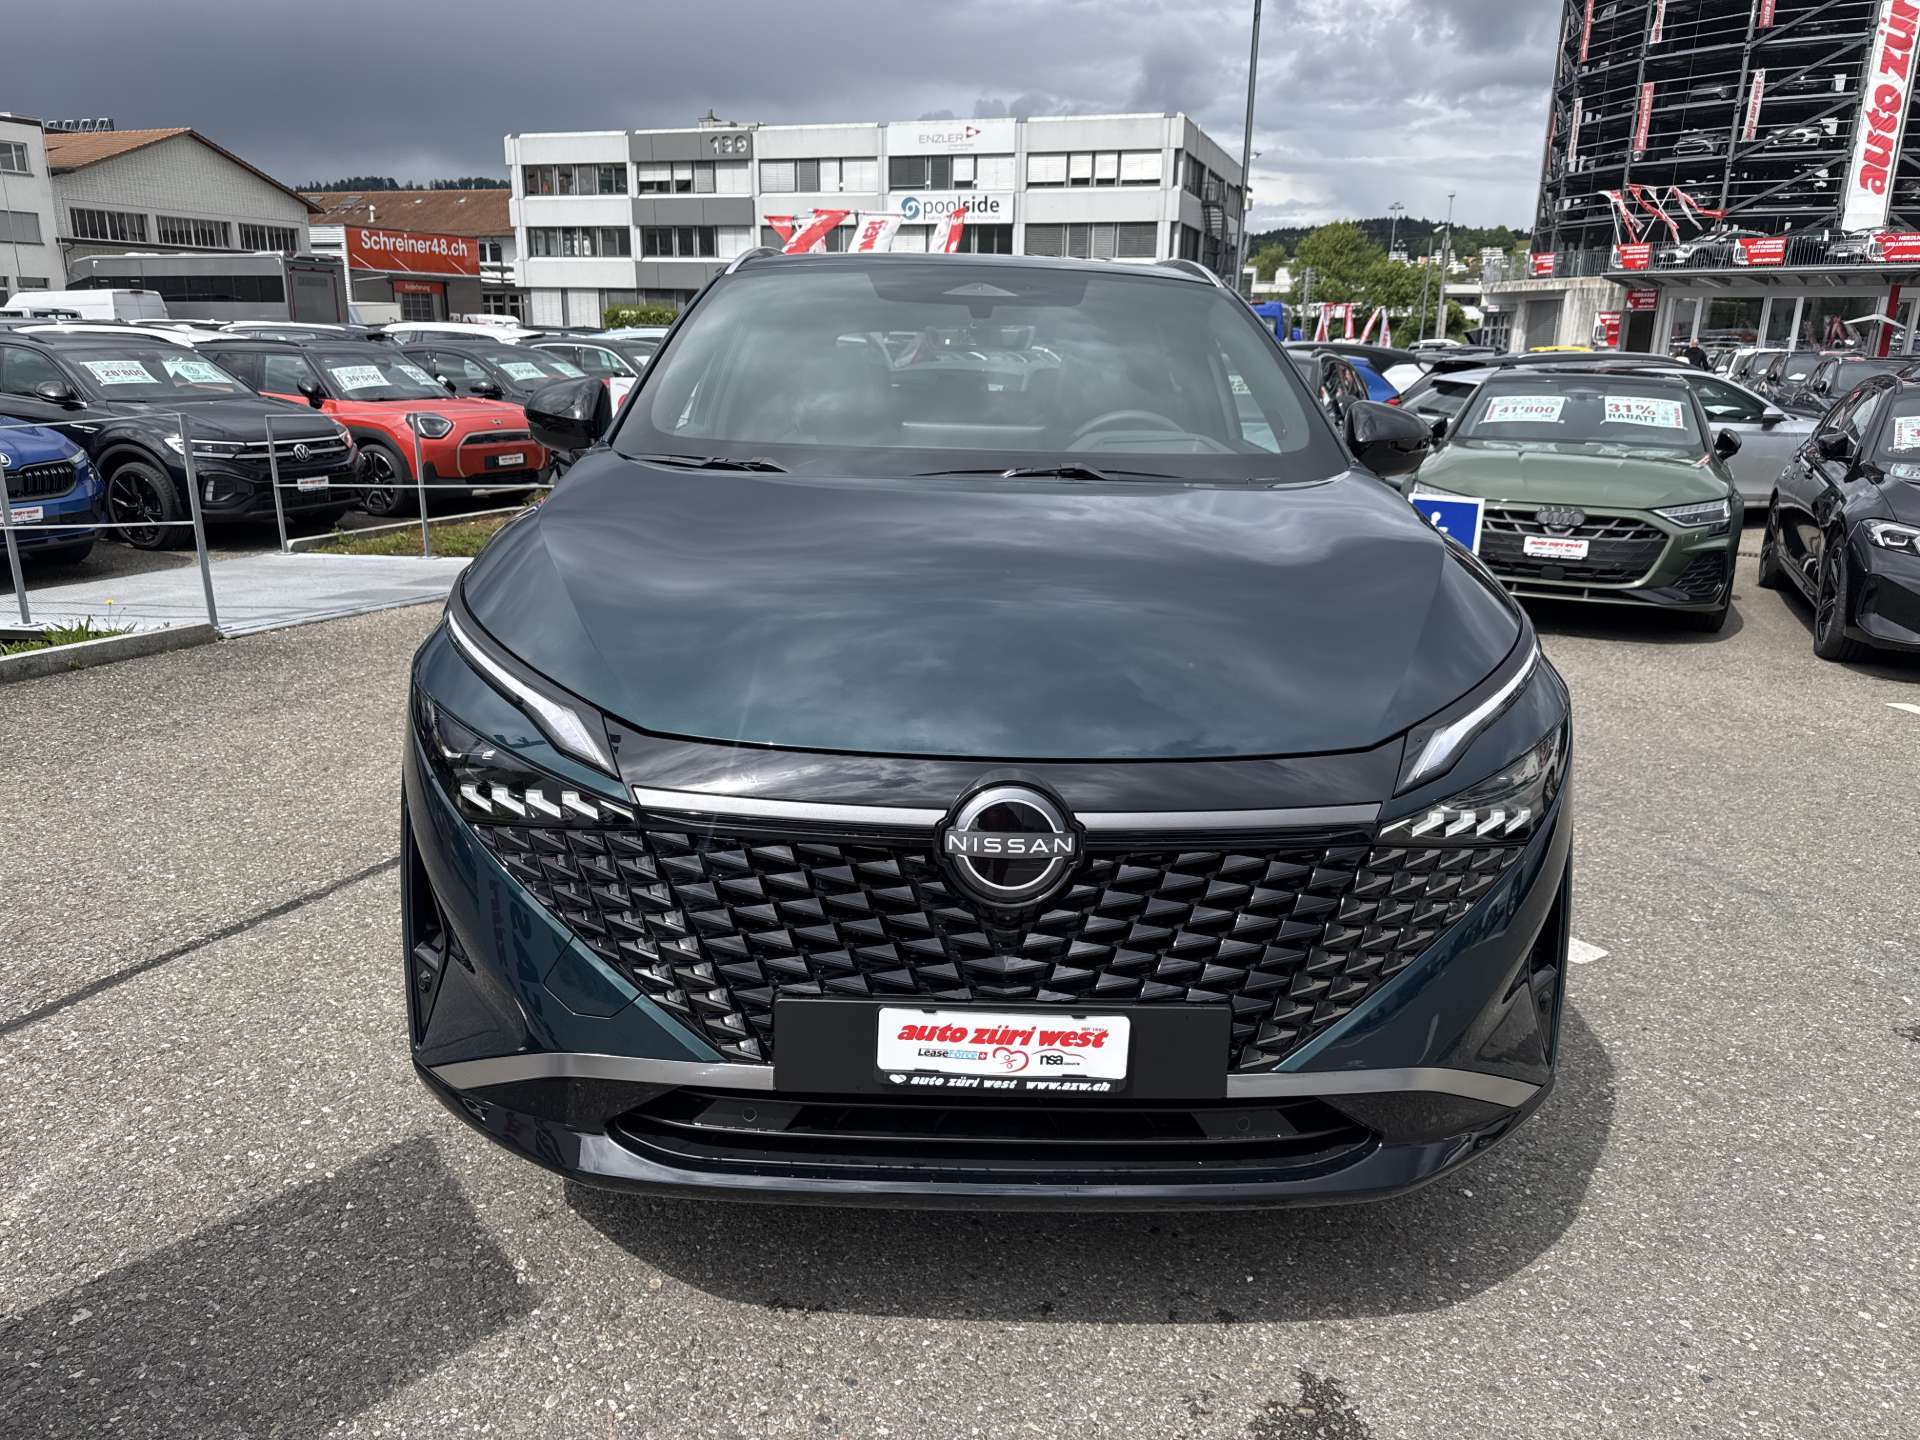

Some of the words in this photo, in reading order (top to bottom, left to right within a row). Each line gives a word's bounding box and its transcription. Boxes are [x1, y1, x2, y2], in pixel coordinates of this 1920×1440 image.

[918, 134, 964, 144] ENZLER
[1860, 84, 1901, 195] auto
[923, 195, 1000, 220] poolside
[361, 229, 467, 257] Schreiner48.ch
[1499, 406, 1556, 414] 41'800
[1608, 403, 1656, 416] 31%
[1608, 413, 1657, 423] RABATT
[948, 834, 1072, 854] NISSAN
[897, 1023, 968, 1044] auto
[969, 1024, 1036, 1046] züri
[1038, 1029, 1109, 1048] west
[1040, 1054, 1064, 1066] nsa
[910, 1075, 944, 1086] auto
[947, 1075, 980, 1088] züri
[983, 1078, 1018, 1090] west
[1025, 1079, 1111, 1092] www.azw.ch
